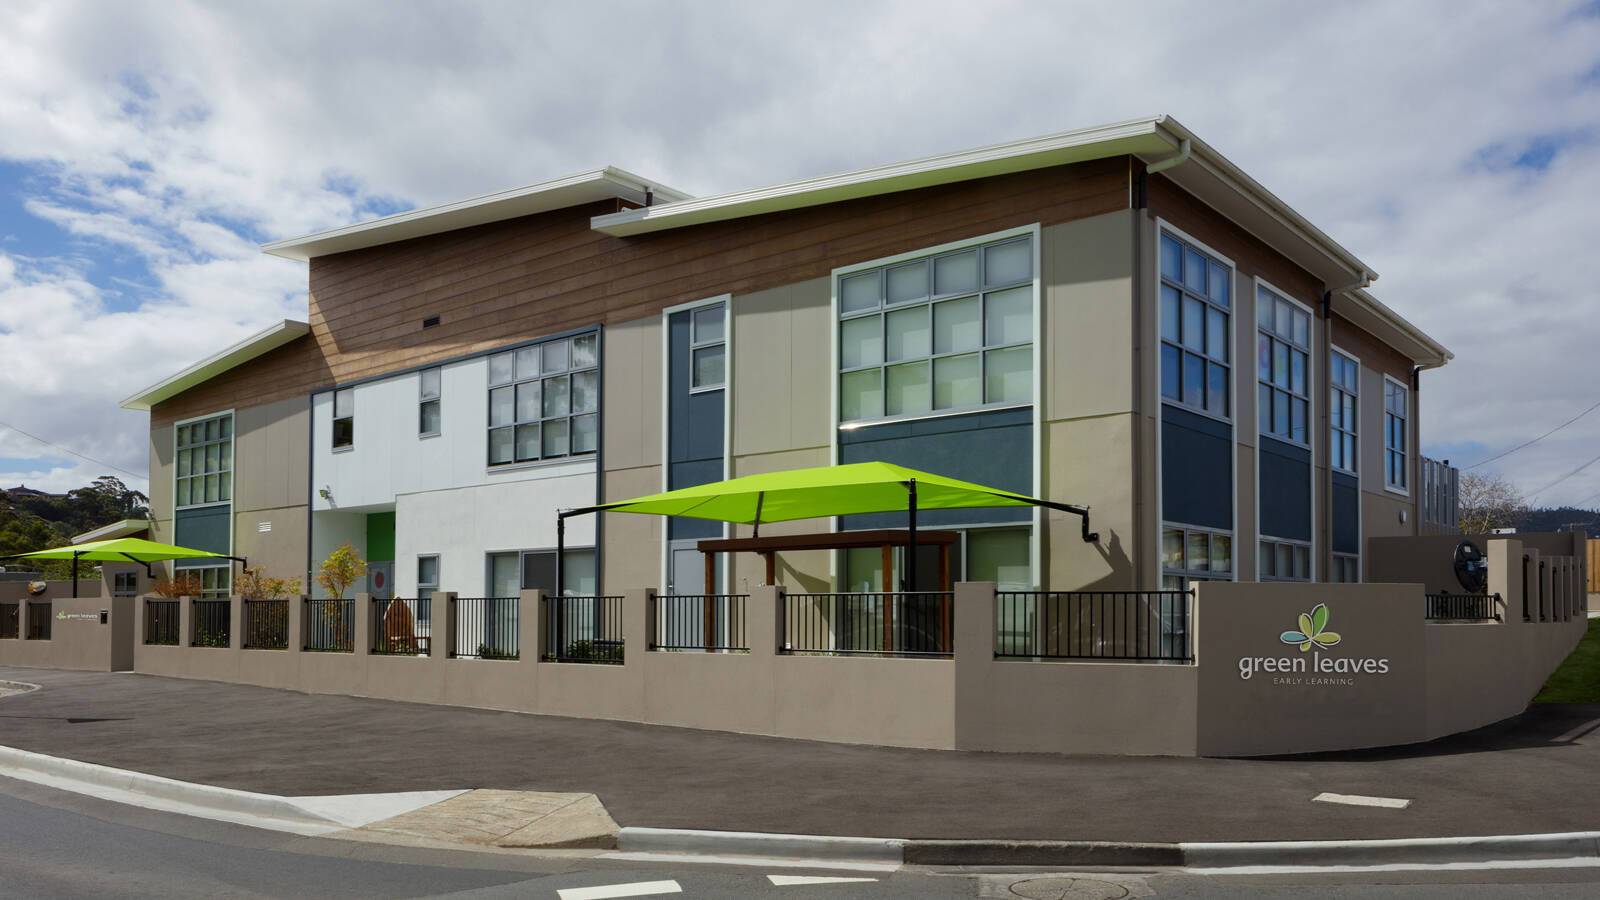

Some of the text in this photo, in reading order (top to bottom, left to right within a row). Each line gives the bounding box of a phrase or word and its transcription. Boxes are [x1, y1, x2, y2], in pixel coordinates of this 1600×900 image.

[1238, 651, 1389, 680] green leaves
[1273, 677, 1354, 685] EARLY LEARNING
